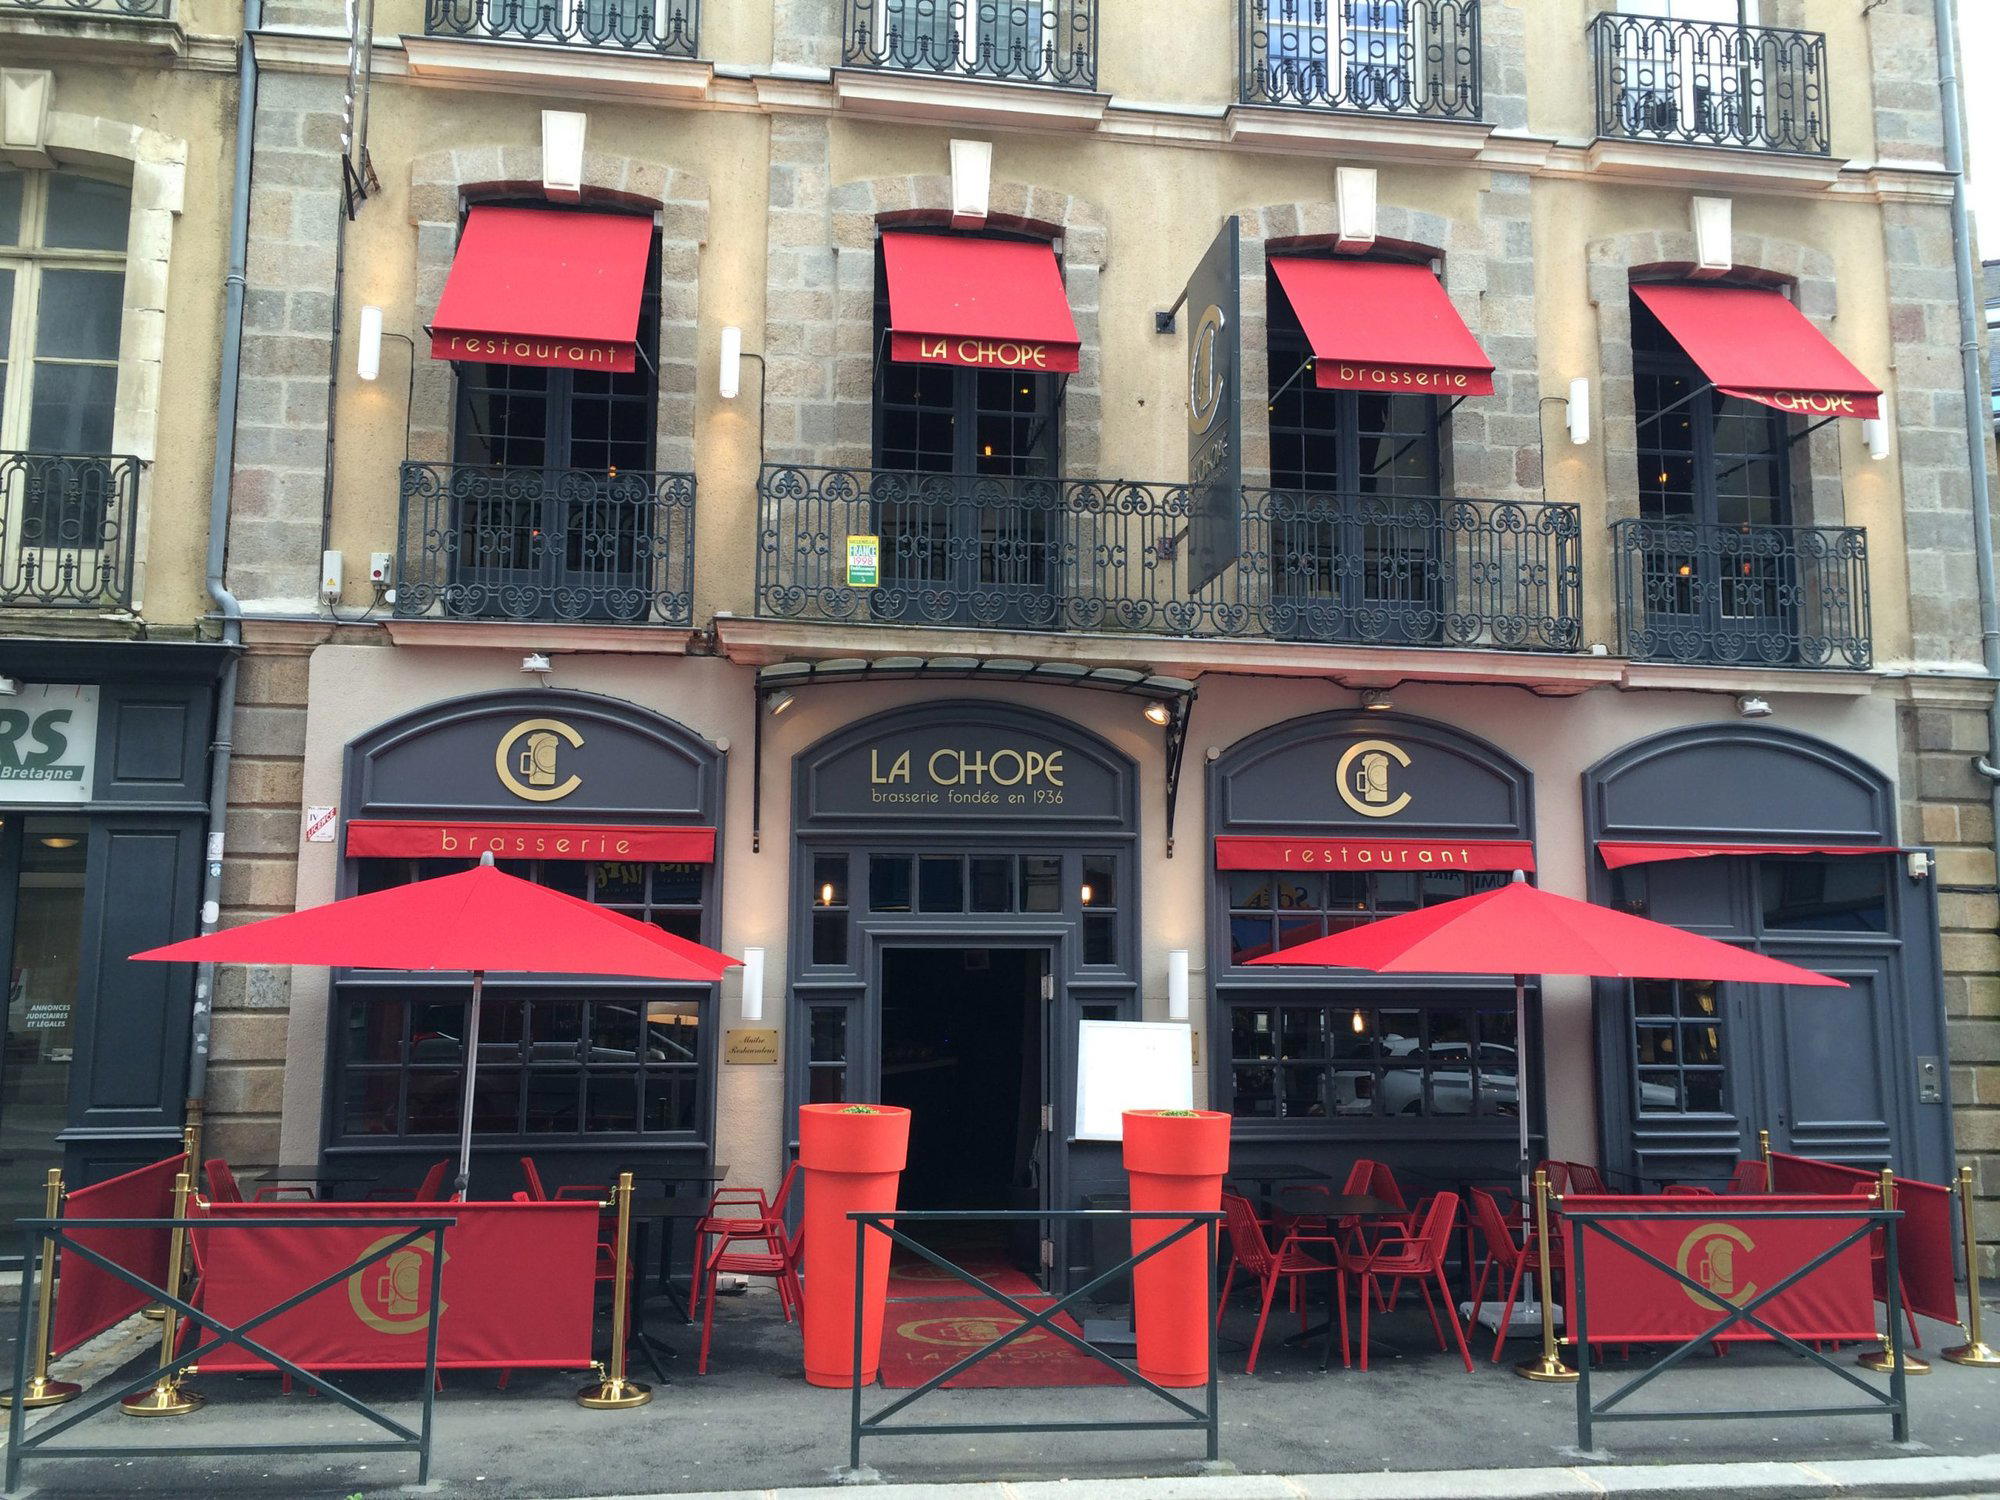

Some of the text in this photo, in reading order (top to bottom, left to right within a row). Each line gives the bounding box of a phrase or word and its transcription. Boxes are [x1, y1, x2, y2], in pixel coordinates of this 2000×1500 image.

[451, 336, 616, 363] restaurant
[921, 336, 1046, 368] LA CHOPE
[1340, 364, 1467, 387] brasserie
[1774, 391, 1854, 413] CHOPE
[853, 557, 874, 566] 1998
[1, 766, 74, 781] Bretagne
[871, 748, 1064, 787] LA CHOPE
[871, 788, 1064, 804] brasserie fondée en 1936
[306, 807, 337, 840] LICENCE
[441, 829, 630, 854] brasserie
[1285, 845, 1470, 864] restaurant
[26, 1012, 68, 1020] JUDICIAIRES
[37, 1020, 66, 1028] LÉGALES
